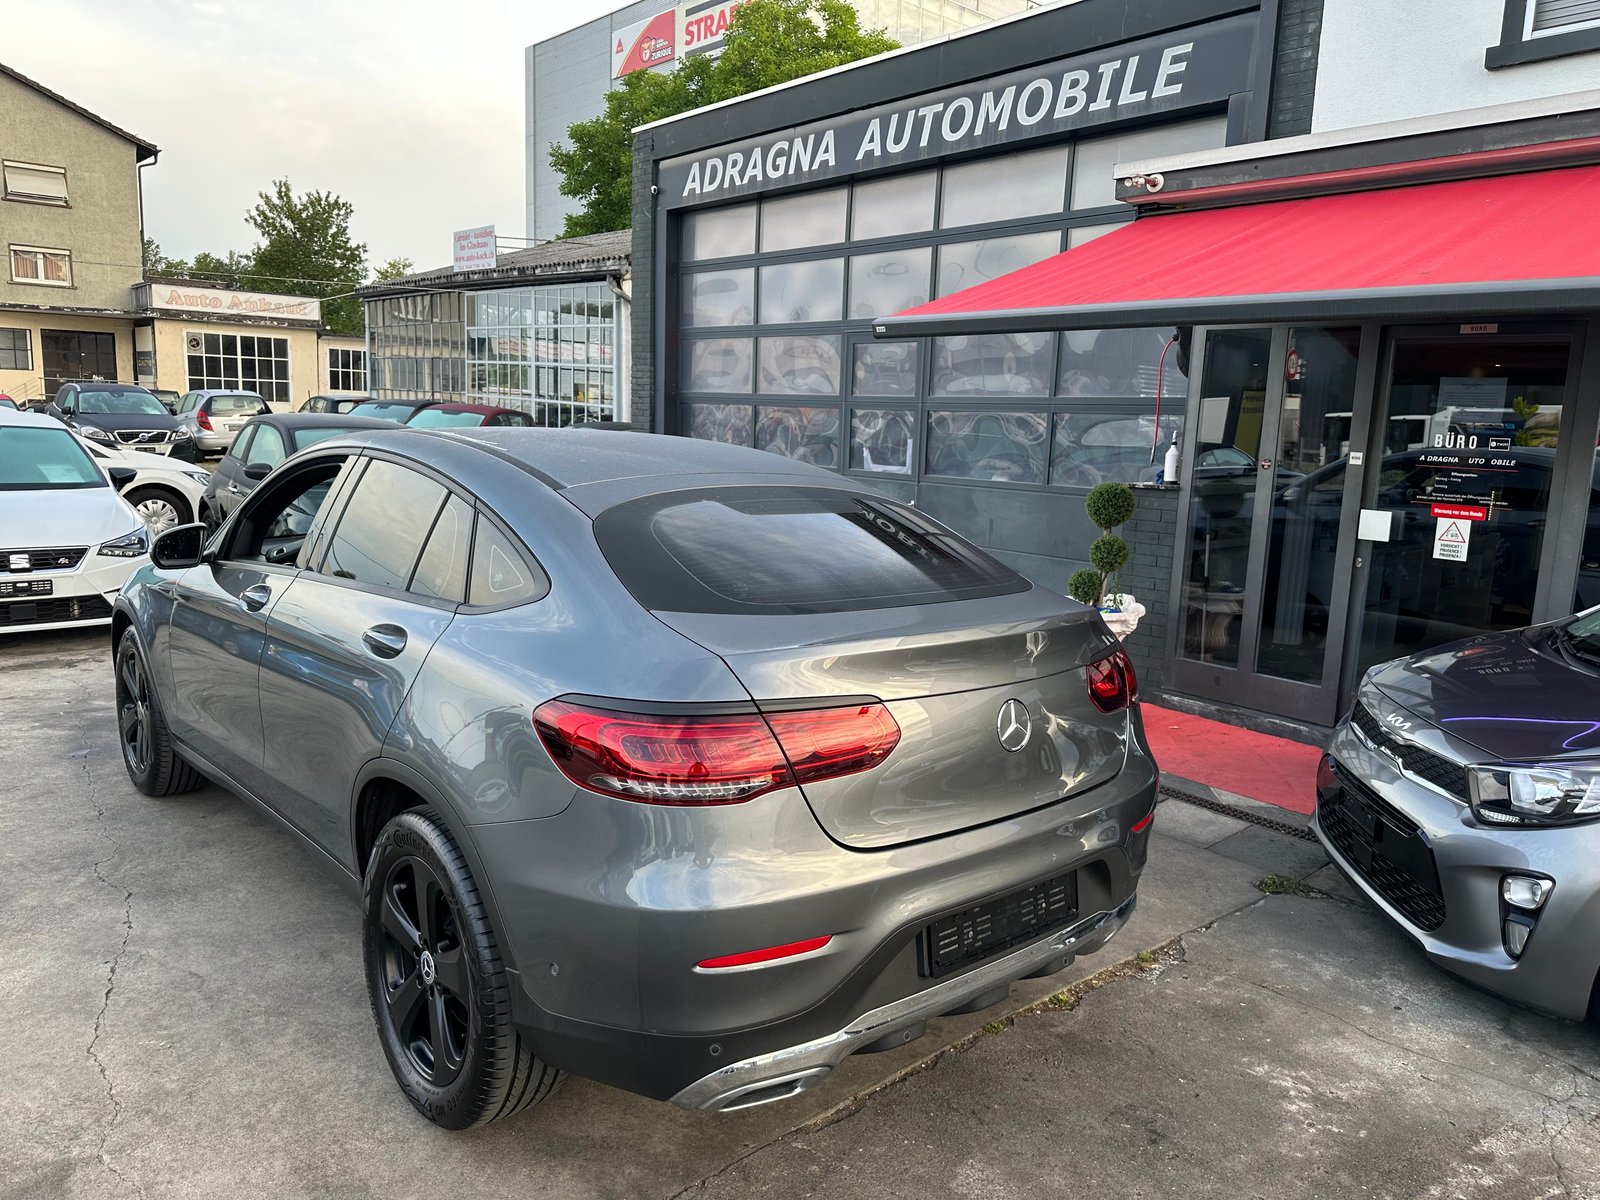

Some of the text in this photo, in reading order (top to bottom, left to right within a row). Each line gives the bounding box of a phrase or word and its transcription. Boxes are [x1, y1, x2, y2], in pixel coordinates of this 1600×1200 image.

[682, 42, 1194, 197] ADRAGNA AUTOMOBILE
[166, 289, 222, 309] Auto
[1434, 432, 1478, 449] BÜRO
